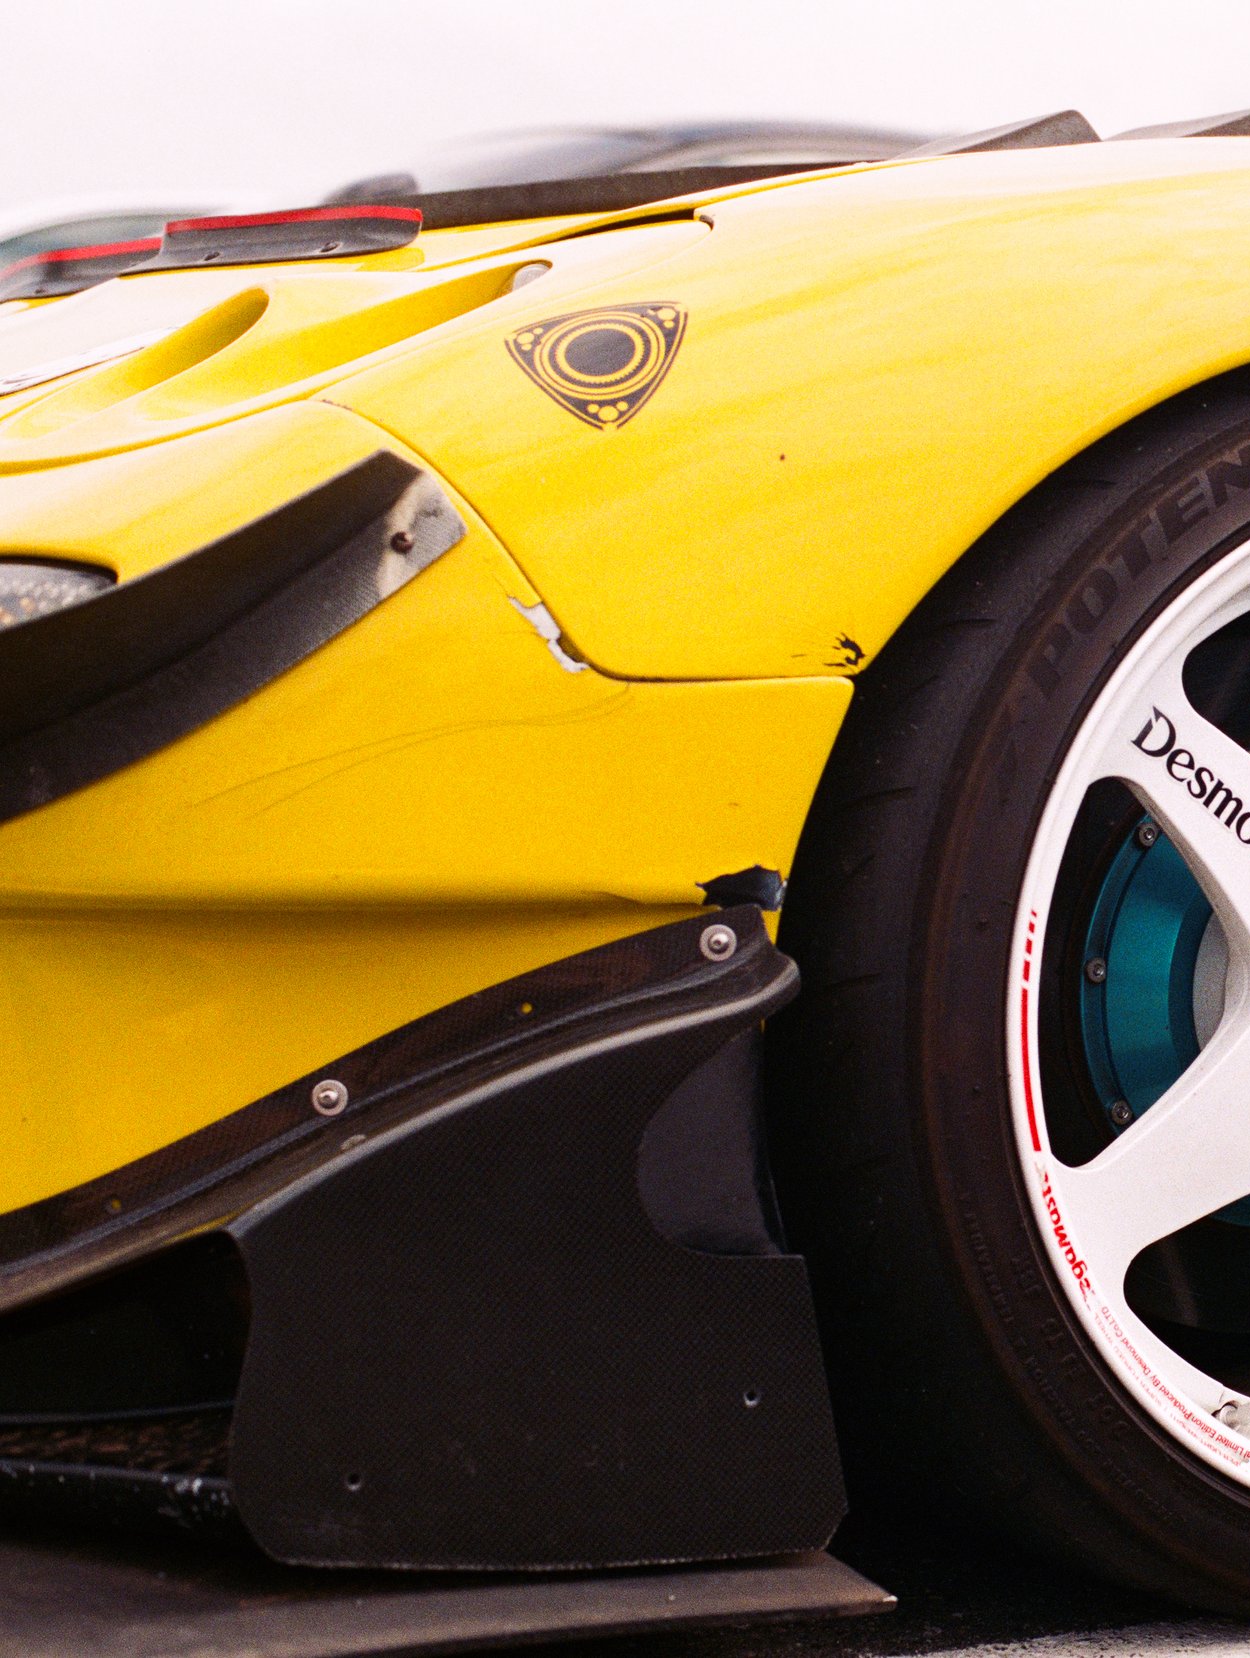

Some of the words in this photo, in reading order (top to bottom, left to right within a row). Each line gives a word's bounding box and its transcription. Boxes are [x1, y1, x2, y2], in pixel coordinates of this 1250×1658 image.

[1159, 1385, 1193, 1420] Produced
[1191, 1416, 1217, 1438] Edition
[1215, 1434, 1245, 1456] Limited
